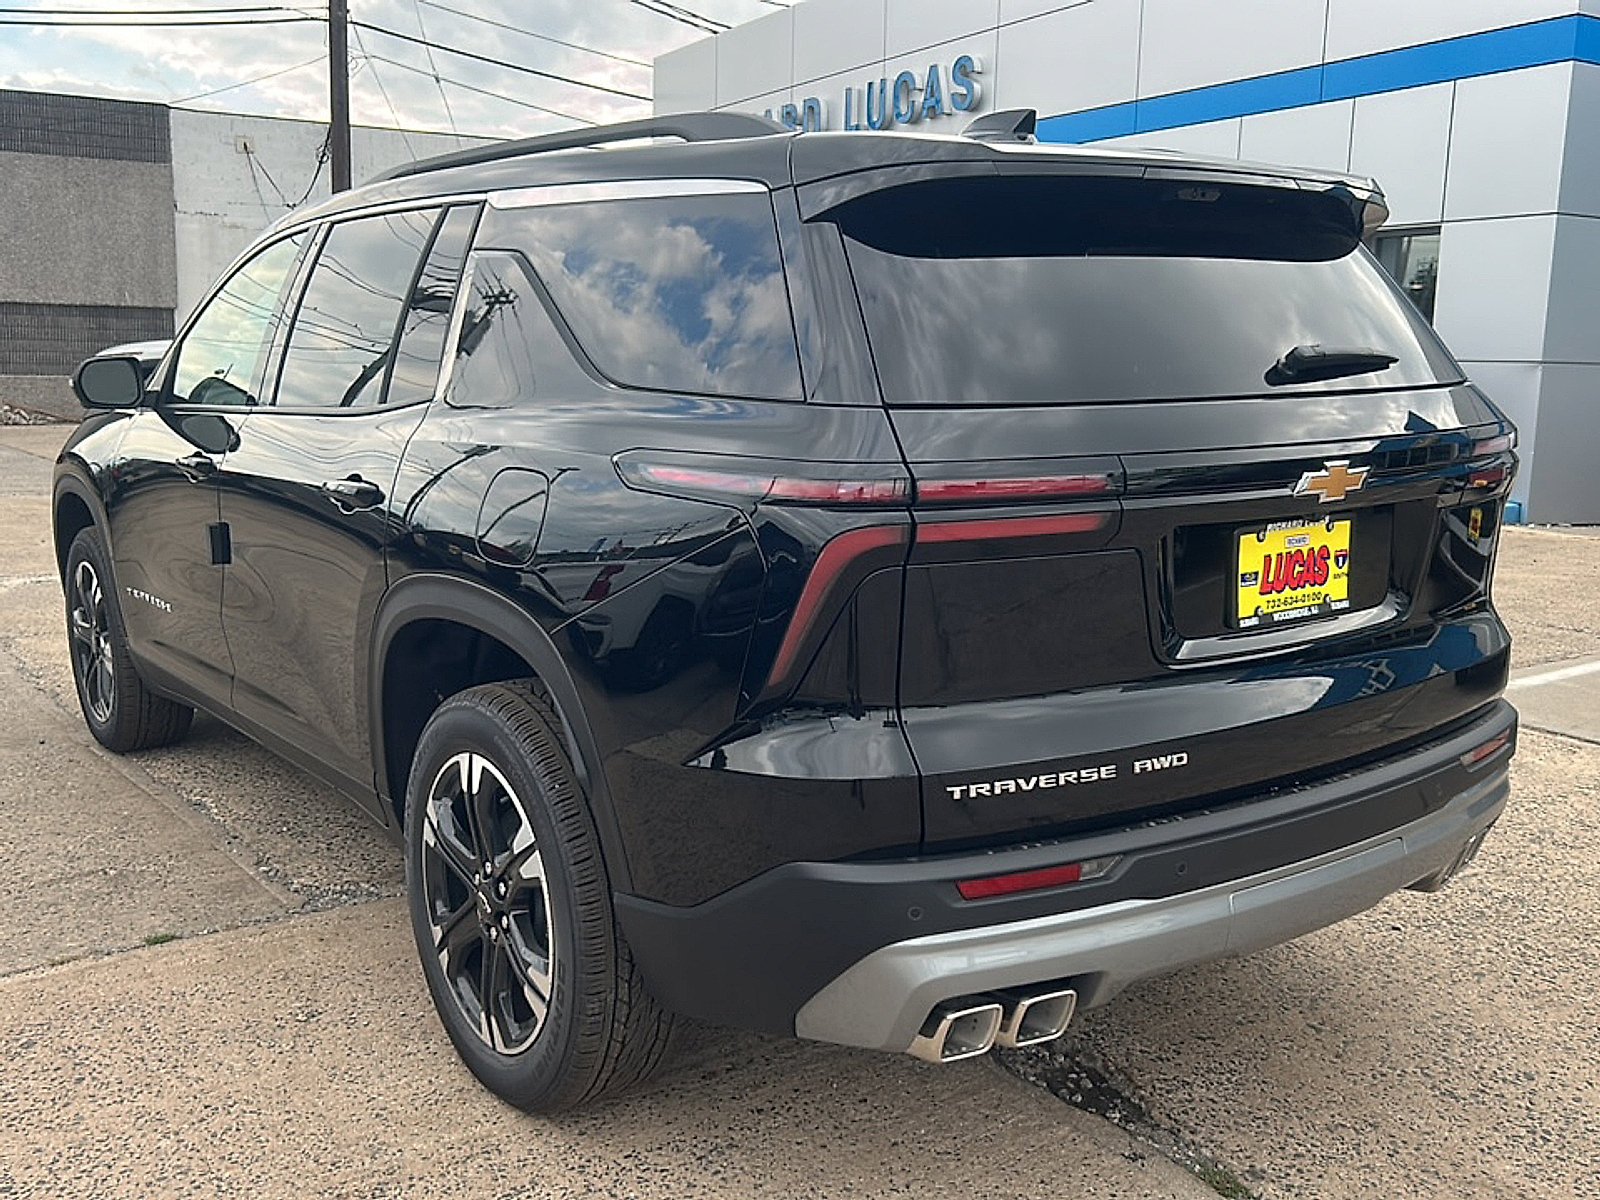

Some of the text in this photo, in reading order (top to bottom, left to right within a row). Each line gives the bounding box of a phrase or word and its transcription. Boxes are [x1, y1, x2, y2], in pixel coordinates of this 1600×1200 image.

[844, 54, 982, 132] LUCAS
[1259, 545, 1330, 595] LUCAS
[946, 752, 1188, 800] TRAVERSE AWD
